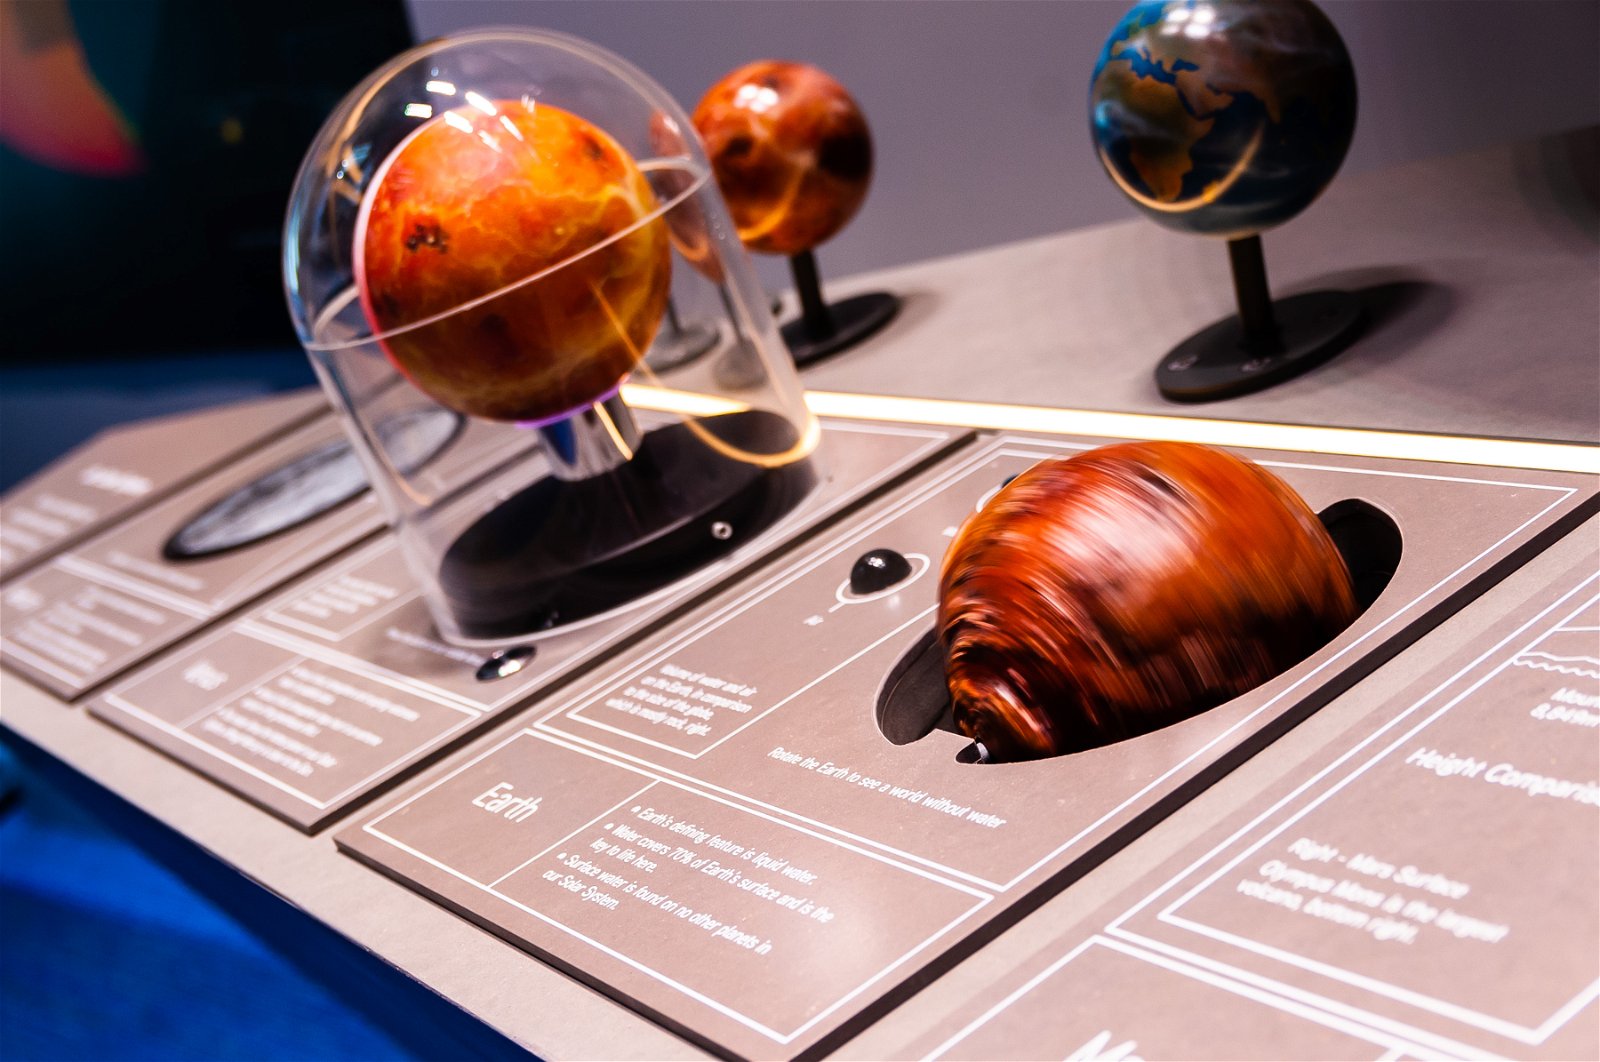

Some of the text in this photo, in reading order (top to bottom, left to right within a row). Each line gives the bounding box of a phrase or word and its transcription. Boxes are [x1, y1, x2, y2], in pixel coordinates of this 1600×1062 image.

[767, 746, 1007, 829] Rotate the Earth to see a world without water
[1405, 746, 1488, 779] Height
[471, 781, 543, 824] Earth
[590, 837, 657, 873] key to life here.
[611, 824, 834, 924] Water covers 70% of Earth's surface and is the
[637, 807, 817, 886] Earth's defining feature is liquid water.
[542, 870, 619, 911] our Solar System.
[564, 854, 773, 956] Surface water is found on no other planets in
